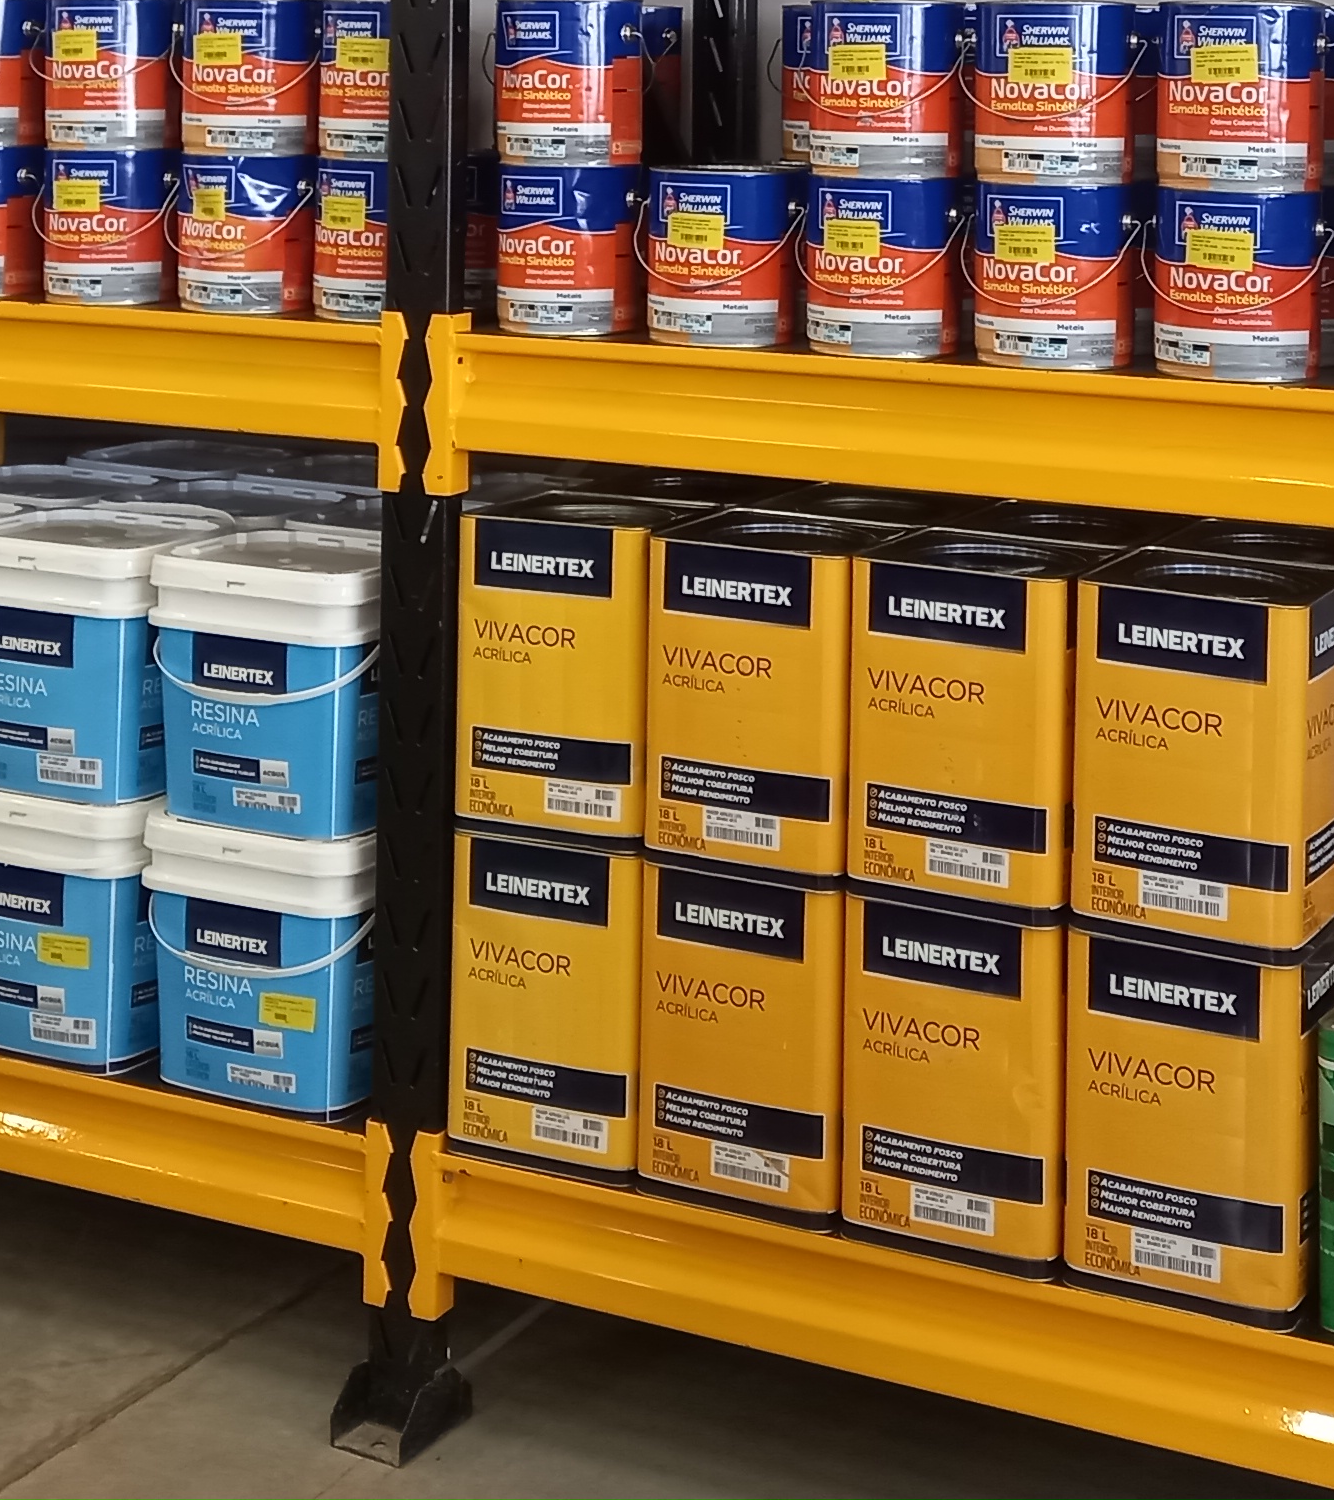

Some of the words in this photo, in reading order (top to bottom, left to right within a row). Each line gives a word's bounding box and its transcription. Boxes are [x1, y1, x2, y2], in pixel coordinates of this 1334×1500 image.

[1169, 103, 1209, 116] Esmalte
[1212, 104, 1268, 117] Sintético
[516, 185, 554, 197] SHERWIN
[491, 551, 594, 578] LEINERTEX
[682, 575, 792, 605] LEINERTEX
[888, 594, 1006, 629] LEINERTEX
[474, 619, 576, 649] VIVACOR
[1118, 623, 1245, 660] LEINERTEX
[473, 646, 532, 665] ACRÍLICA
[663, 645, 772, 678] VIVACOR
[203, 662, 273, 685] LEINERTEX
[191, 702, 259, 727] RESINA
[1096, 697, 1224, 738] VIVACOR
[1096, 727, 1169, 750] ACRÍLICA
[1107, 823, 1170, 842] ACABAMENTO
[1171, 835, 1203, 848] FOSCO
[1107, 835, 1144, 850] MELHOR
[1146, 843, 1201, 859] COBERTURA
[1107, 847, 1137, 860] MAIOR
[1138, 853, 1197, 870] RENDIMENTO
[486, 871, 589, 904] LEINERTEX
[1092, 872, 1104, 884] 18
[196, 929, 267, 954] LEINERTEX
[882, 936, 1001, 975] LEINERTEX
[1110, 974, 1237, 1015] LEINERTEX
[1088, 1048, 1216, 1093] VIVACOR
